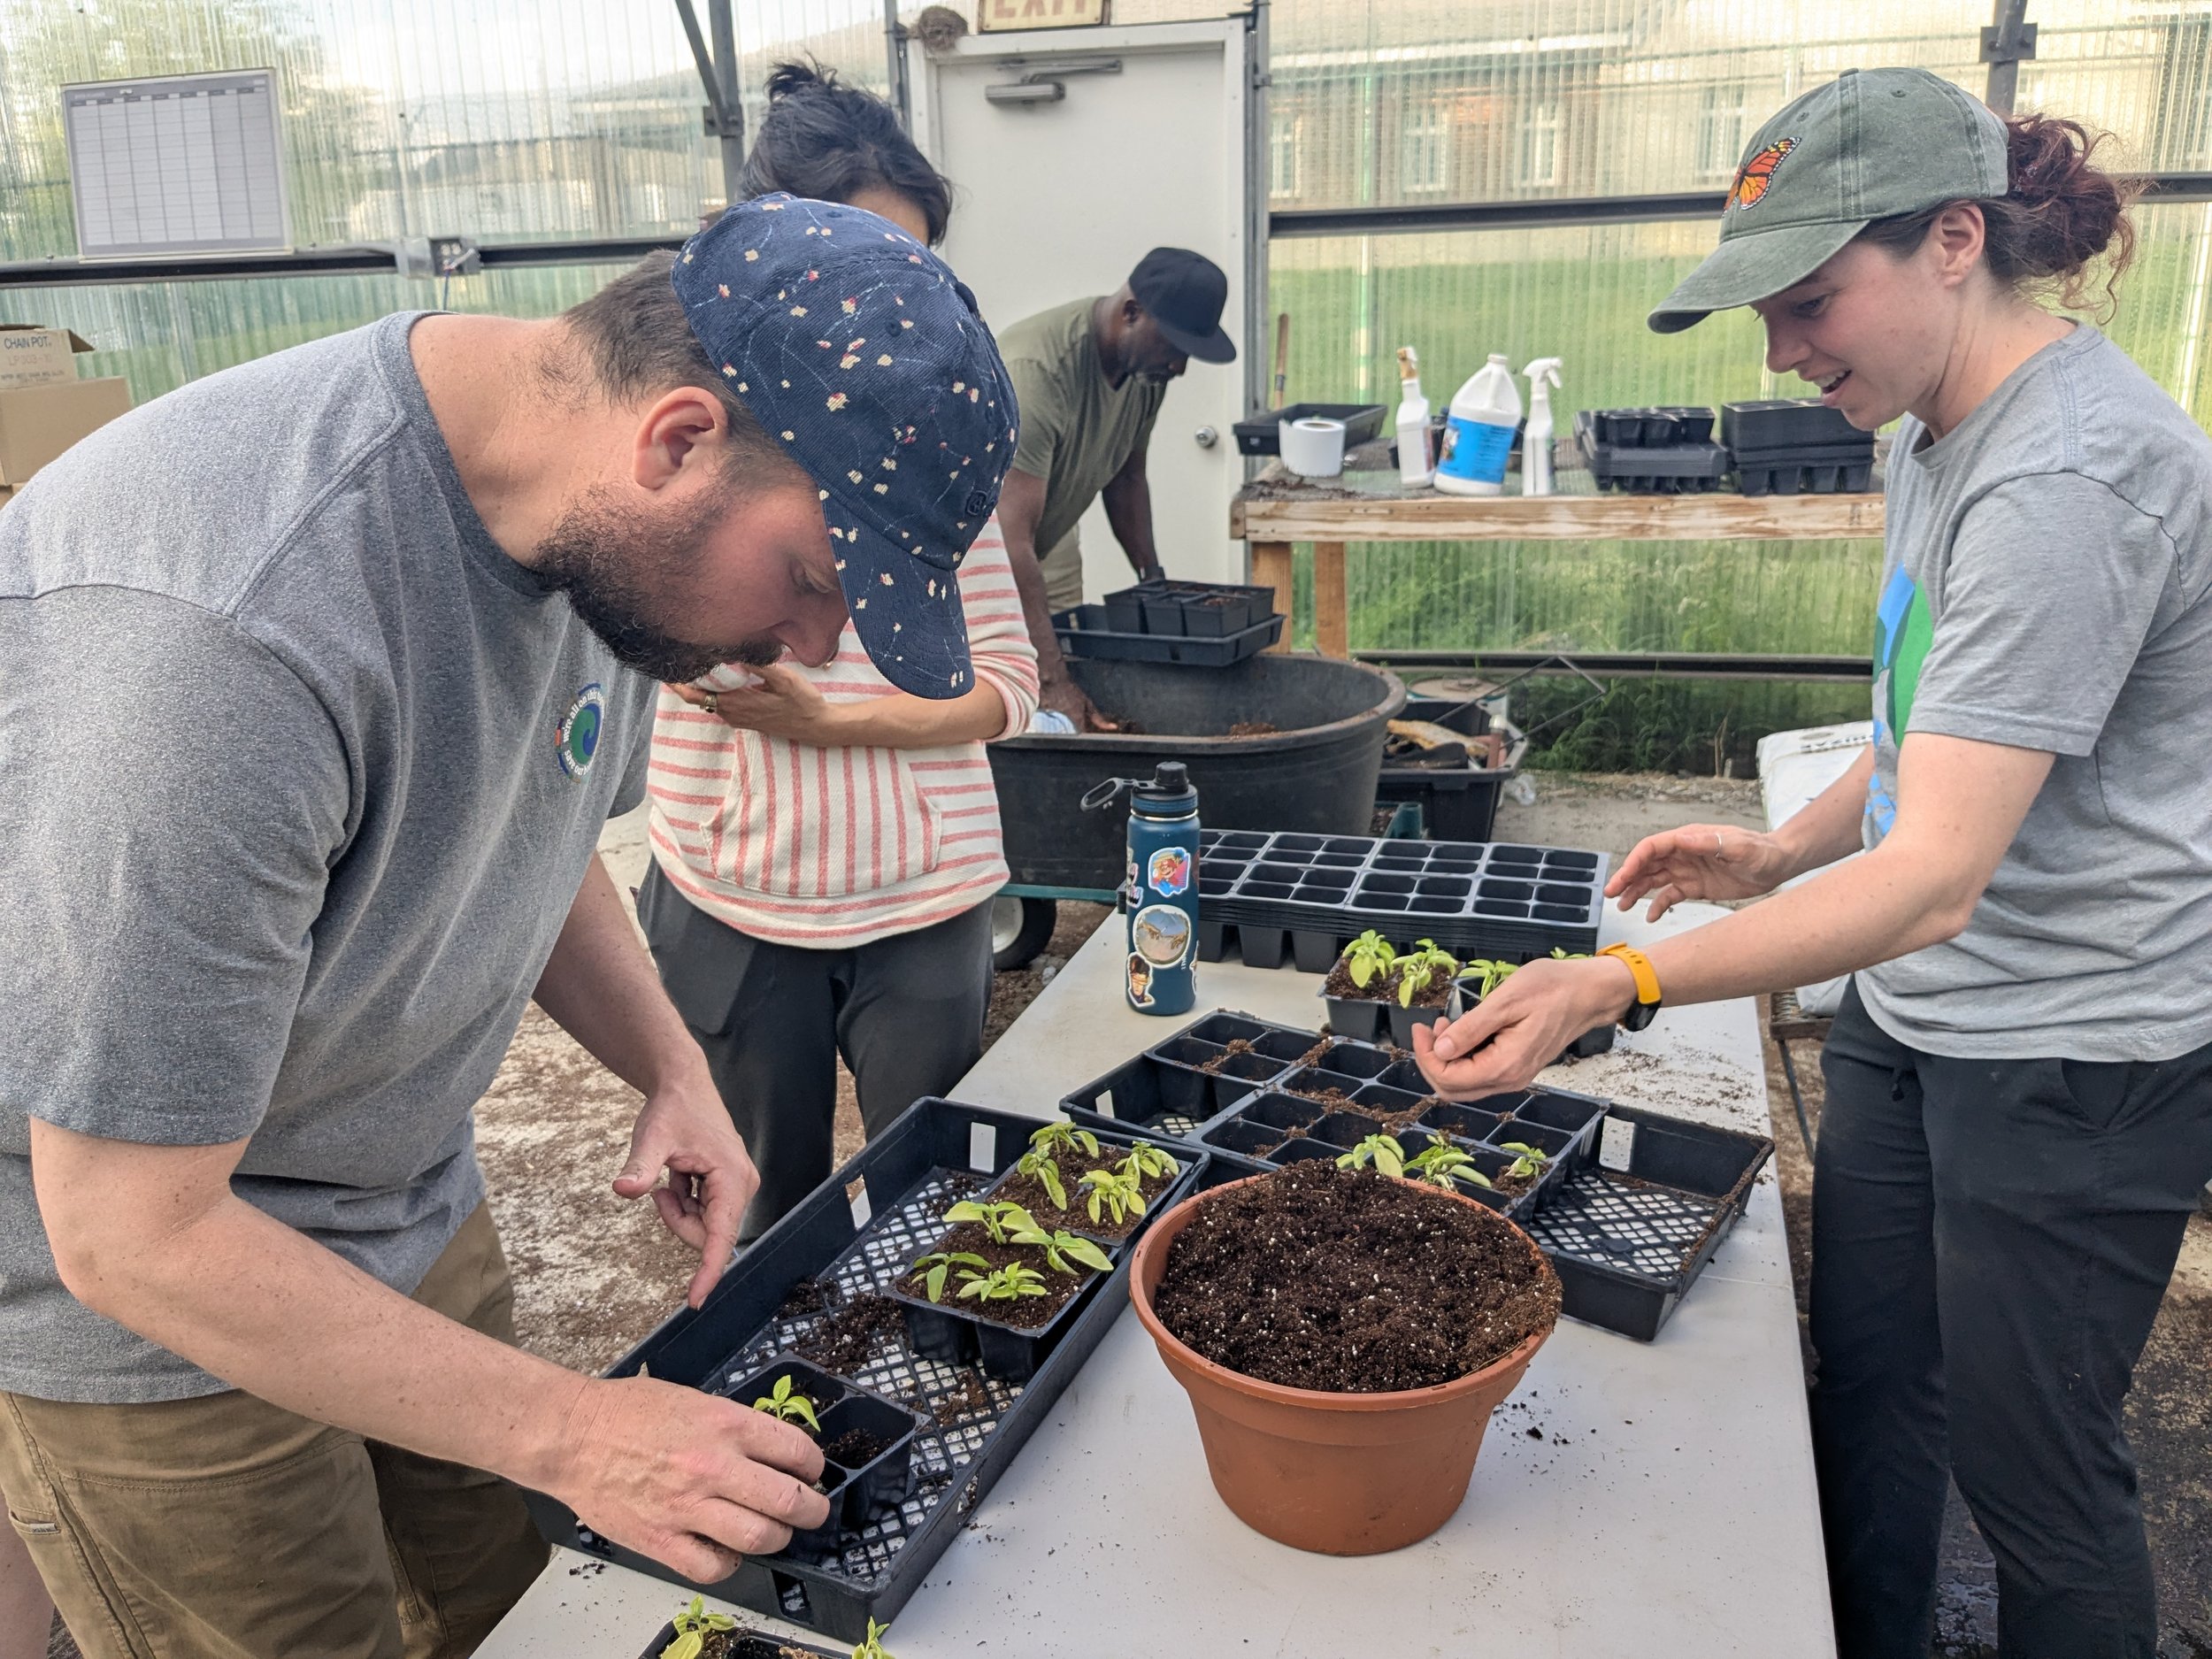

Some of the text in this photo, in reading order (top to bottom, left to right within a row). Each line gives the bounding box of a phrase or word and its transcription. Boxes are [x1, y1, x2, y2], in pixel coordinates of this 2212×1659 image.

[4, 338, 30, 349] CHAIN
[570, 703, 580, 719] all
[579, 696, 588, 708] on
[565, 749, 575, 769] save
